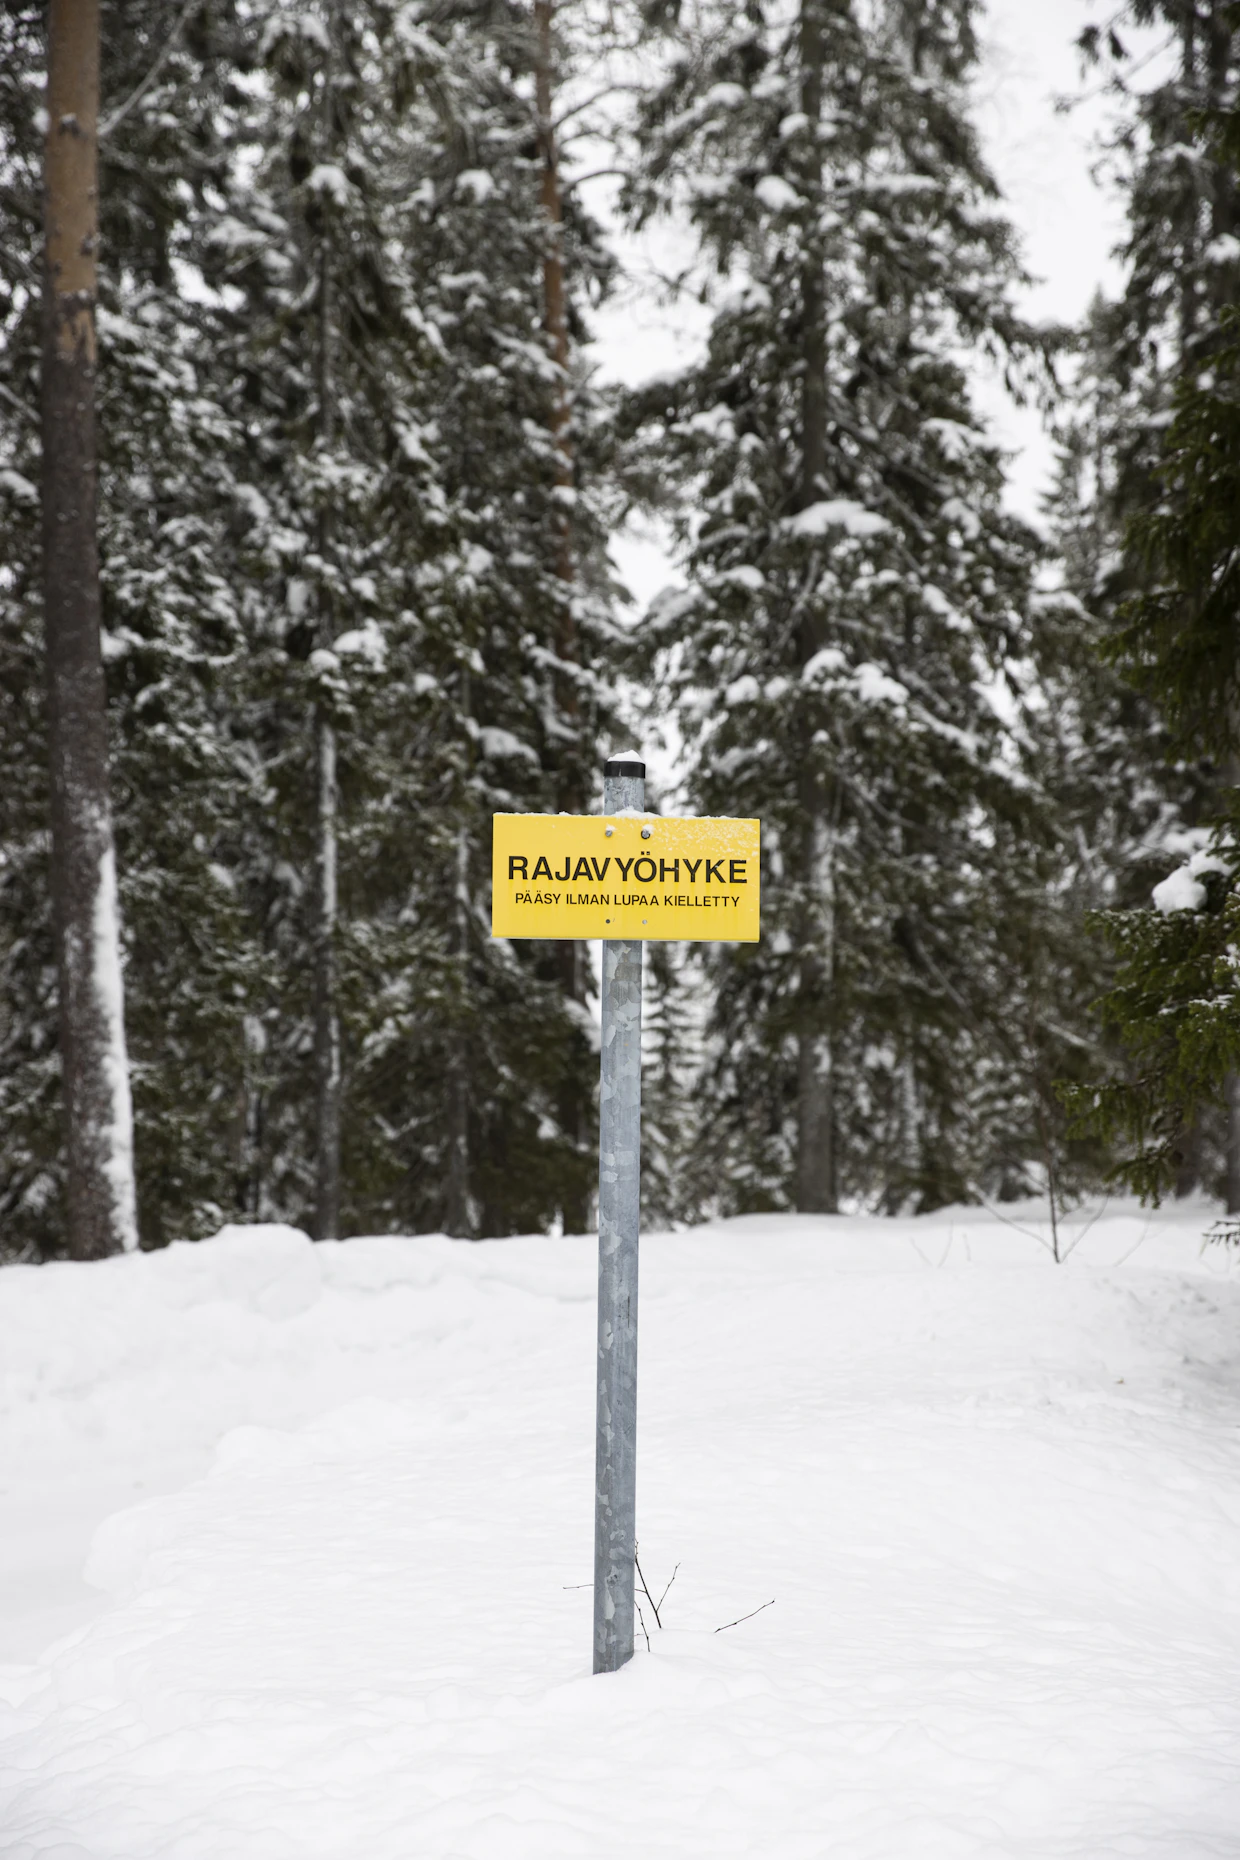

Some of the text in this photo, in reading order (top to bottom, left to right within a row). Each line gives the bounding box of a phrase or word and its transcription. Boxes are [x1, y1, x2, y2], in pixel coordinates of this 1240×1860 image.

[508, 851, 748, 883] RAJAVYÖHYKE
[515, 890, 740, 907] PÄÄSY ILMAN LUPAA KIELLETTY
